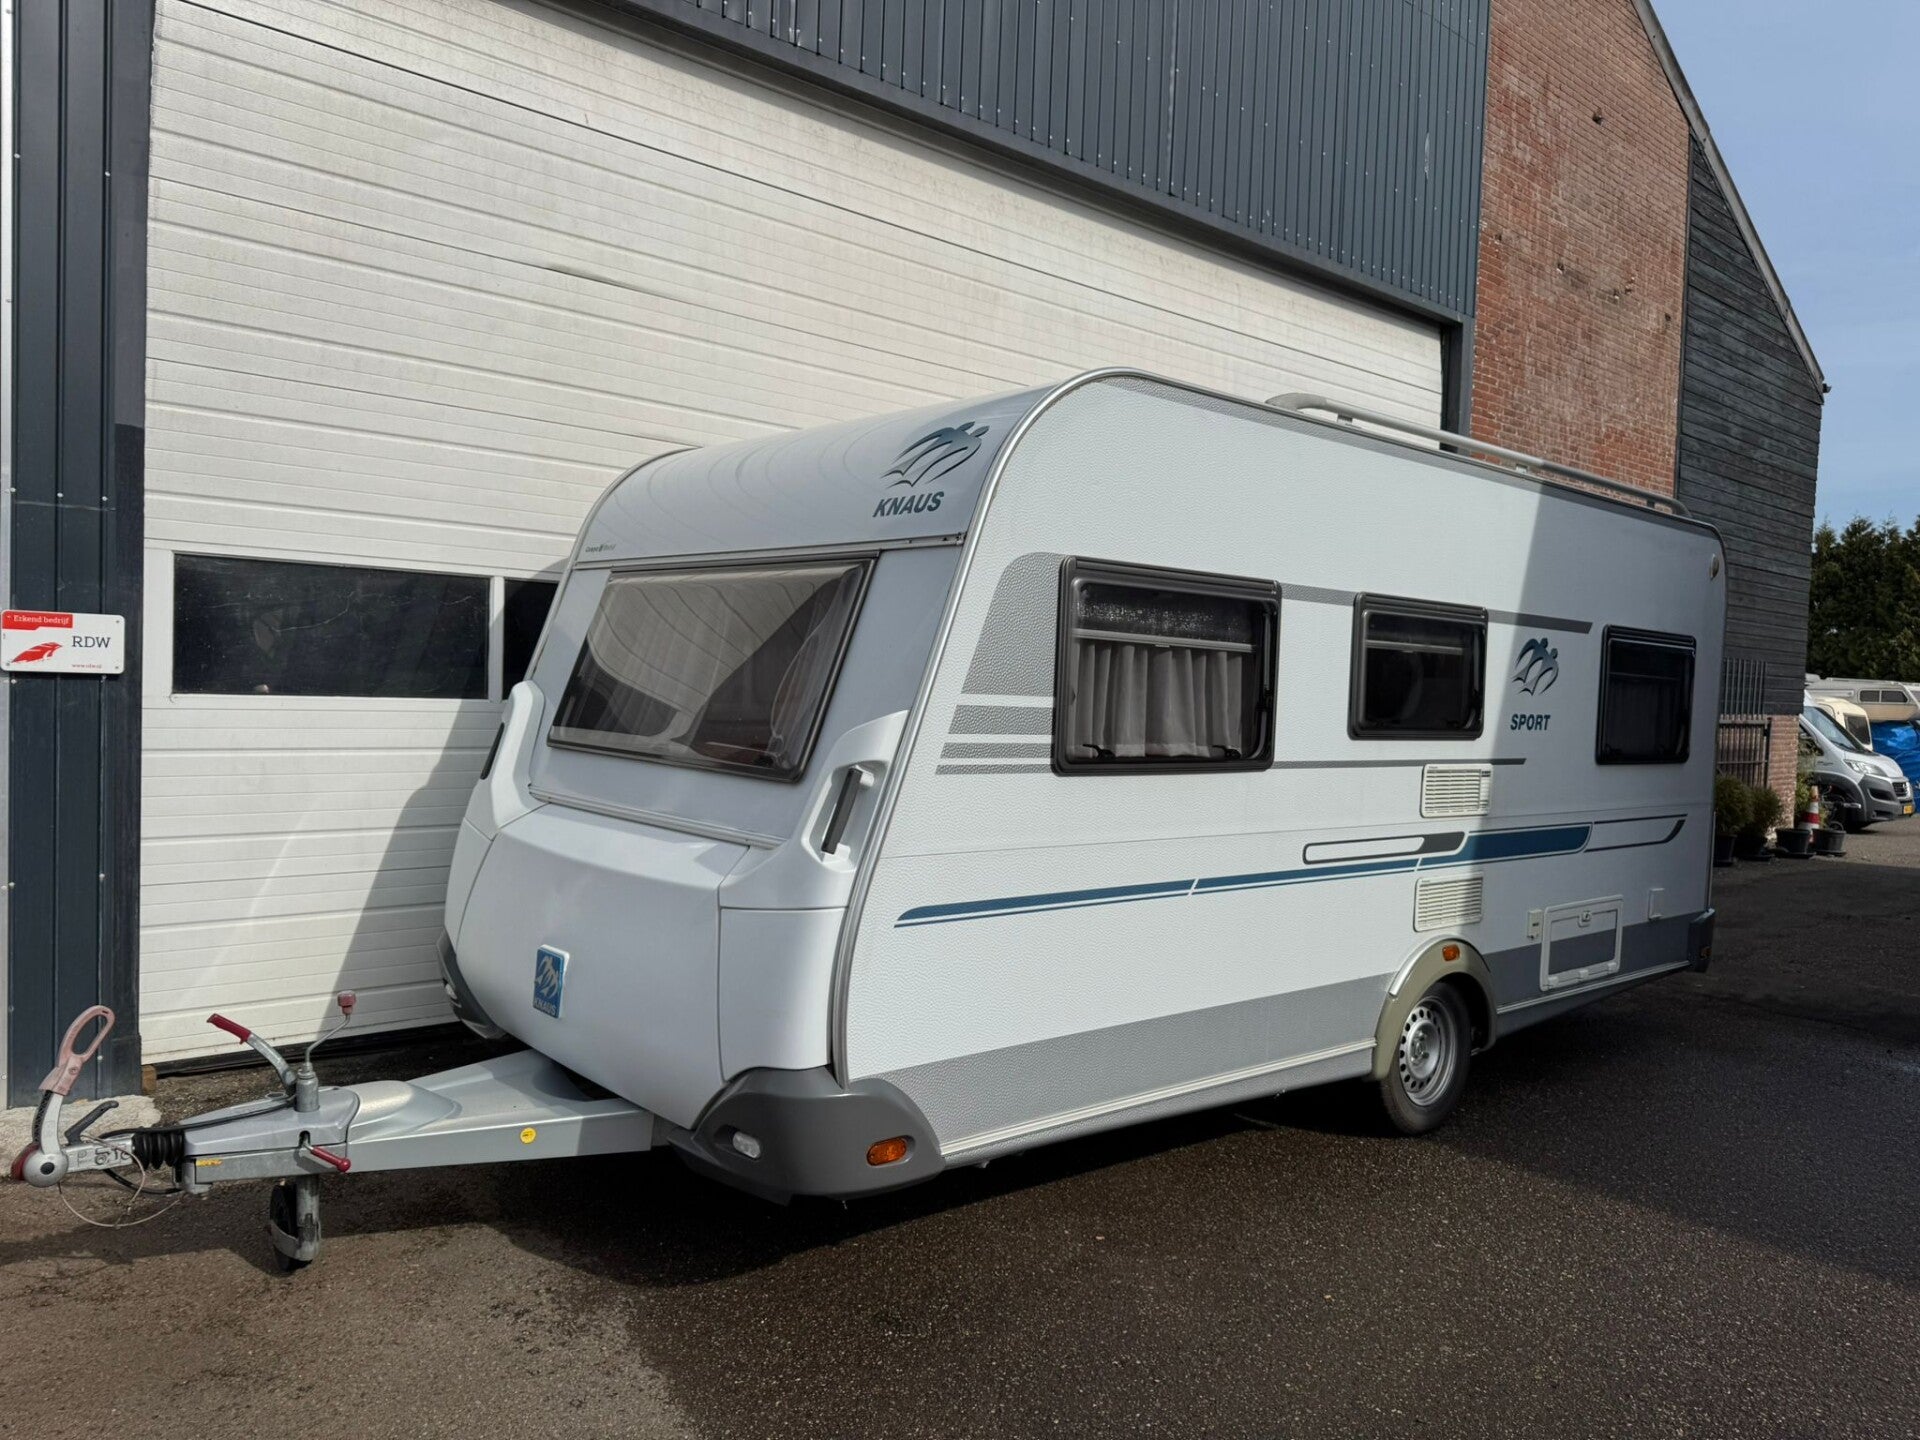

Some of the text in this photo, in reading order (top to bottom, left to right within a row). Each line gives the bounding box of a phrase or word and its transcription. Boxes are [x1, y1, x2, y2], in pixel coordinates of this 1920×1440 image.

[872, 491, 945, 518] KNAUS
[13, 614, 69, 625] Erkend bedrijf
[72, 635, 111, 648] RDW
[1510, 713, 1552, 731] SPORT
